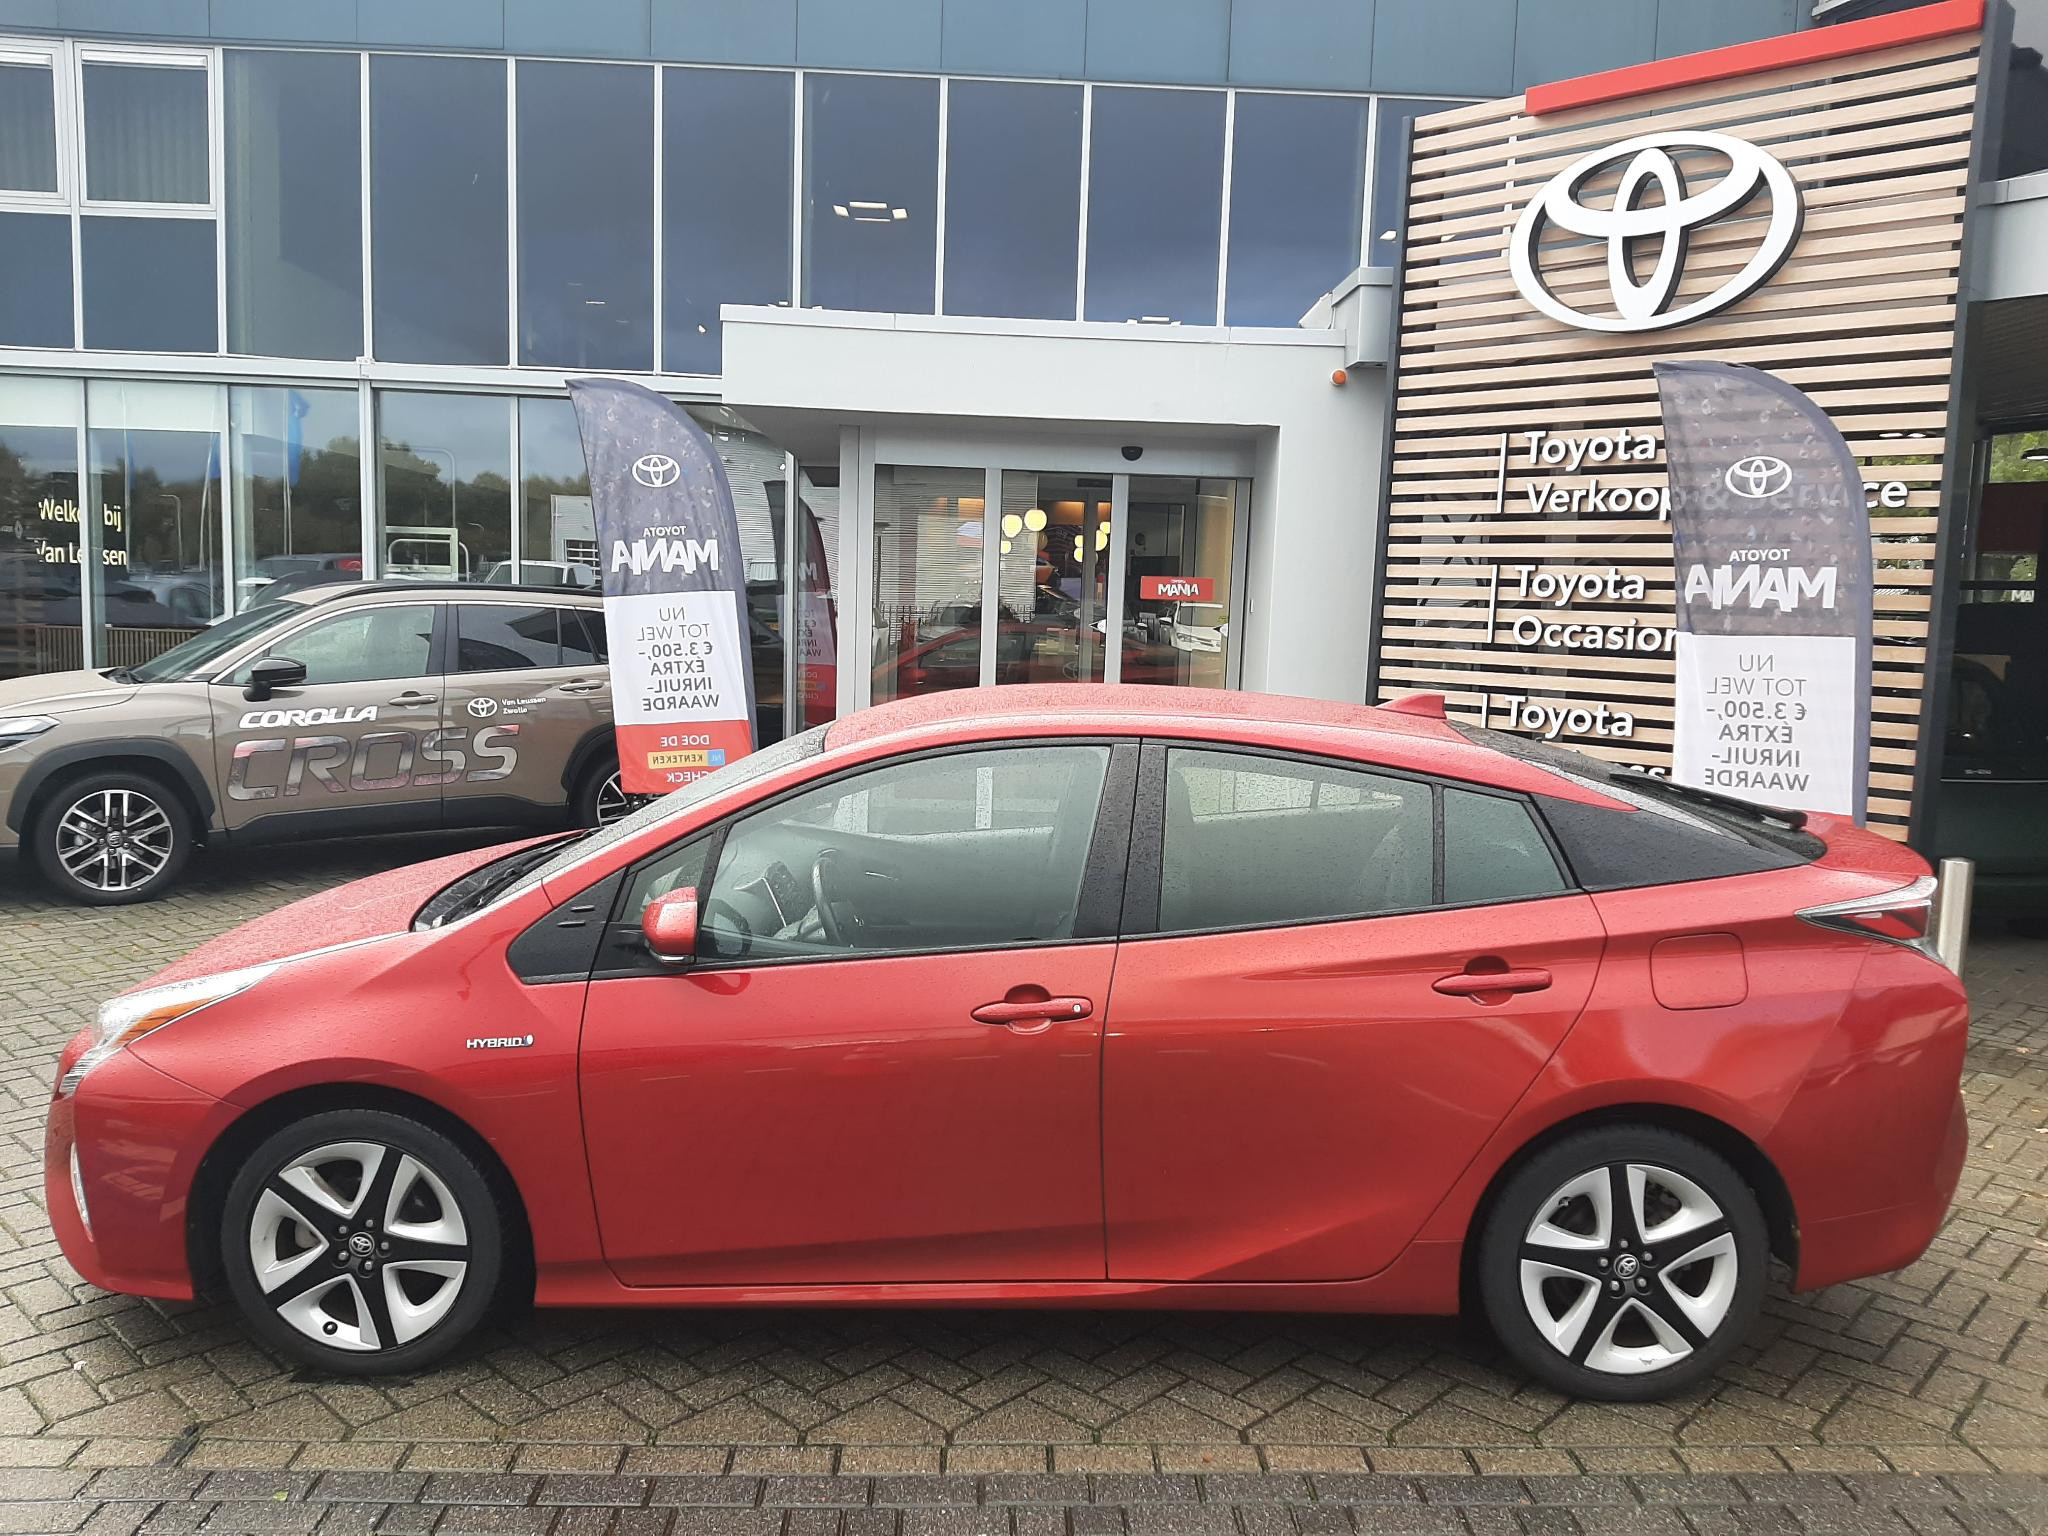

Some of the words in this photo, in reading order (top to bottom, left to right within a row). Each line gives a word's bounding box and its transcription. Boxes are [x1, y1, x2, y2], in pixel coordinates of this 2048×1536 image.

[1524, 429, 1656, 472] Toyota
[103, 503, 122, 532] bij
[1157, 583, 1199, 597] MANIA
[1514, 565, 1646, 607] Toyota
[238, 705, 378, 729] COROLLA
[1504, 695, 1635, 739] Toyota
[226, 724, 521, 801] CROSS
[466, 1036, 523, 1049] HYBRID
